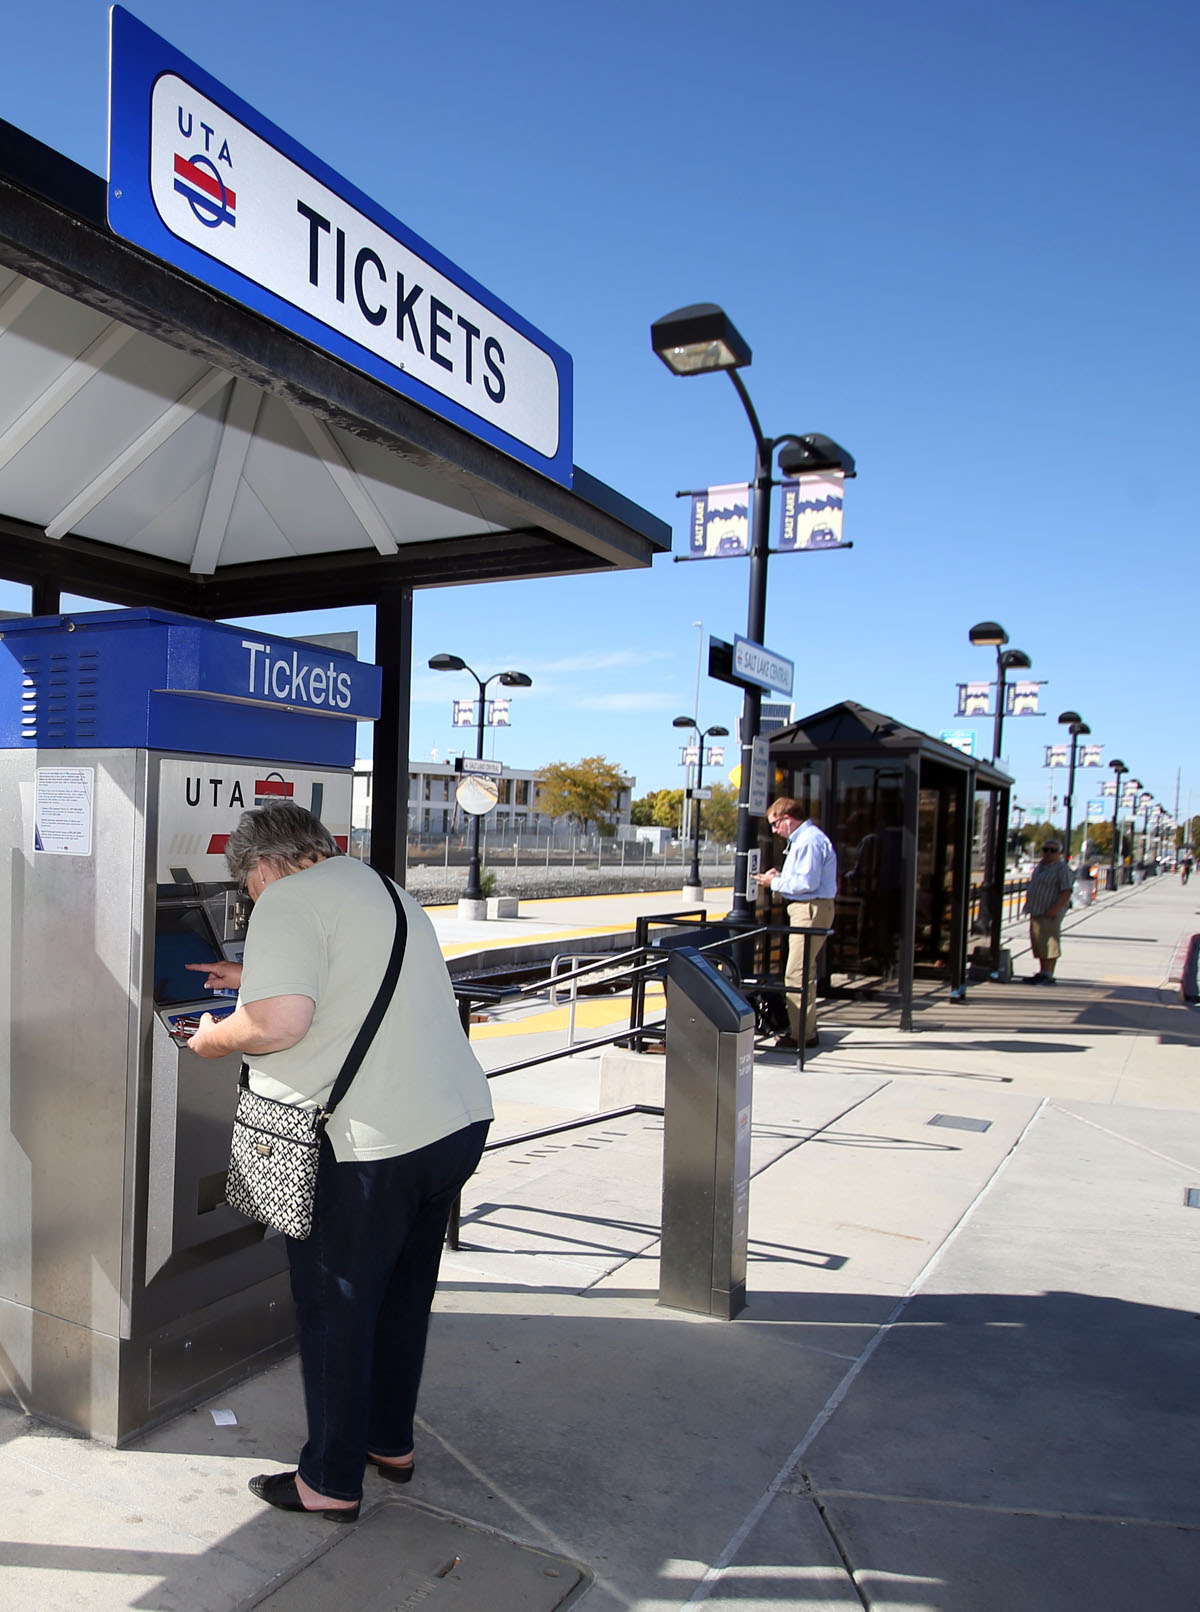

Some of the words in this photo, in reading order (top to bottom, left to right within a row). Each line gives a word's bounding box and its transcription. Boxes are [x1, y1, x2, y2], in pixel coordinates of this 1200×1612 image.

[177, 105, 234, 168] UTA
[296, 198, 506, 404] TICKETS
[696, 501, 704, 523] LAKE
[786, 491, 796, 514] LAKE
[695, 524, 704, 546] SALT
[784, 515, 794, 539] SALT
[241, 640, 352, 708] Tickets
[744, 652, 757, 670] SALT
[757, 656, 769, 677] LAKE
[186, 776, 244, 808] UTA
